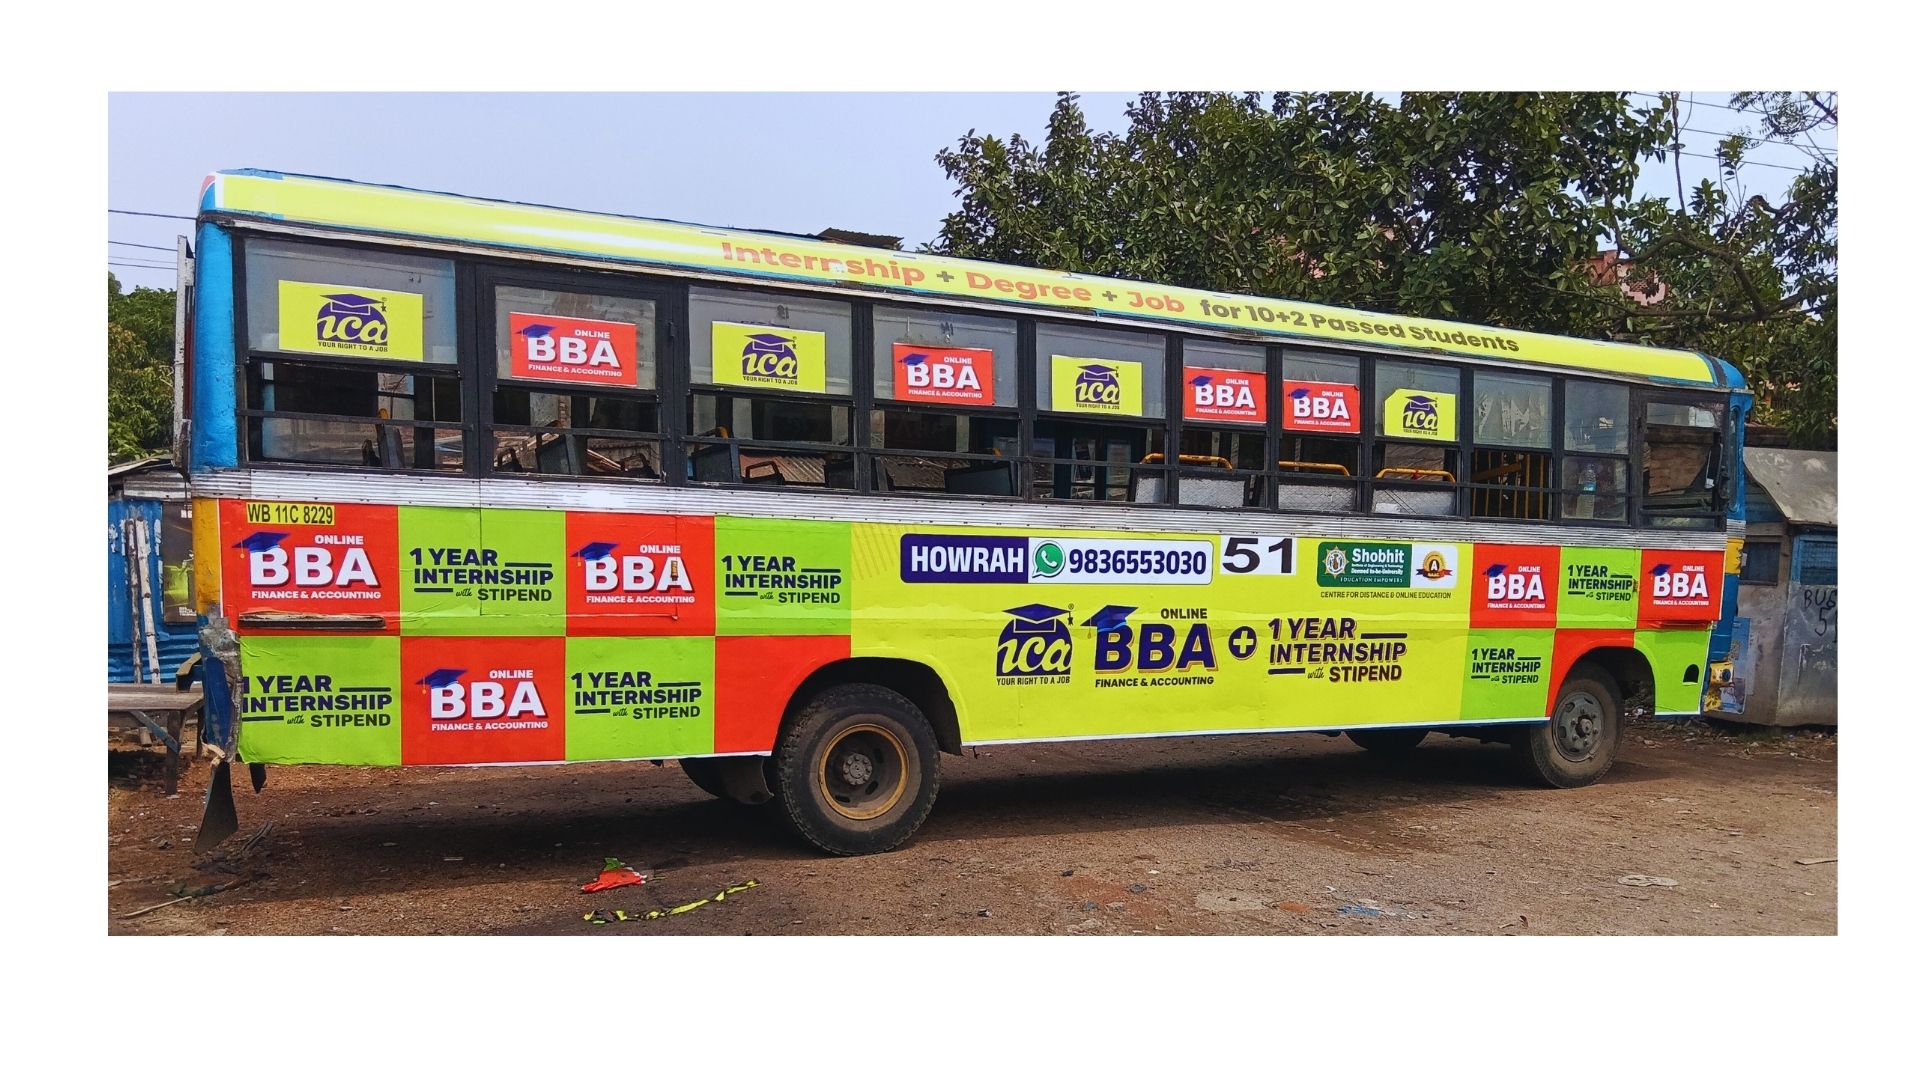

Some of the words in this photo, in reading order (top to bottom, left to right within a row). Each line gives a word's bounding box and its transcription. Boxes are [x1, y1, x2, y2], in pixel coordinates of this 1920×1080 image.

[966, 272, 1092, 301] Degree
[1127, 291, 1185, 313] Job
[1200, 299, 1241, 319] for
[1244, 305, 1307, 327] 10+2
[1309, 313, 1406, 338] Passed
[1408, 326, 1519, 352] Students
[574, 329, 610, 339] ONLINE
[528, 334, 620, 370] BBA
[528, 364, 563, 372] FINANCE
[571, 368, 622, 377] ACCOUNTING
[907, 362, 980, 389] BBA
[1195, 384, 1255, 408] BBA
[1294, 396, 1349, 419] BBA
[247, 504, 271, 522] WB
[275, 505, 299, 524] 11C
[303, 506, 333, 525] 8229
[315, 535, 363, 545] ONLINE
[410, 548, 422, 565] 1
[428, 548, 498, 566] YEAR
[640, 545, 681, 554] ONLINE
[1222, 537, 1292, 573] 51
[1352, 548, 1404, 563] Shobhit
[250, 545, 378, 585] BBA
[721, 555, 732, 571] 1
[737, 555, 795, 572] YEAR
[912, 546, 1024, 573] HOWRAH
[1069, 549, 1206, 575] 9836553030
[1431, 560, 1438, 570] A
[414, 568, 553, 585] INTERNSHIP
[585, 554, 692, 591] BBA
[1568, 565, 1574, 576] 1
[1576, 565, 1608, 577] YEAR
[726, 574, 841, 589] INTERNSHIP
[1488, 573, 1544, 599] BBA
[1569, 578, 1632, 590] INTERNSHIP
[1653, 572, 1708, 597] BBA
[455, 588, 473, 597] with
[478, 588, 552, 601] STIPEND
[760, 591, 774, 600] with
[778, 592, 840, 603] STIPEND
[1596, 592, 1631, 601] STIPEND
[1161, 608, 1207, 619] ONLINE
[1268, 618, 1280, 641] 1
[1288, 618, 1356, 640] YEAR
[1095, 623, 1216, 673] BBA
[1270, 642, 1406, 663] INTERNSHIP
[1472, 648, 1478, 660] 1
[1481, 648, 1515, 660] YEAR
[489, 670, 533, 679] ONLINE
[1307, 667, 1324, 679] with
[1329, 665, 1402, 682] STIPEND
[1472, 661, 1541, 673] INTERNSHIP
[256, 675, 332, 694] YEAR
[571, 672, 582, 688] 1
[588, 671, 651, 688] YEAR
[997, 678, 1015, 686] YOUR
[1017, 677, 1038, 685] RIGHT
[1057, 676, 1070, 684] JOB
[1095, 678, 1138, 688] FINANCE
[1140, 678, 1148, 686] &
[1150, 676, 1214, 686] ACCOUNTING
[1502, 675, 1539, 684] STIPEND
[243, 694, 392, 712] INTERNSHIP
[431, 681, 545, 718] BBA
[575, 688, 702, 706] INTERNSHIP
[287, 714, 305, 724] with
[311, 714, 391, 727] STIPEND
[612, 708, 628, 717] with
[633, 706, 700, 720] STIPEND
[432, 723, 474, 731] FINANCE
[484, 721, 548, 730] ACCOUNTING
